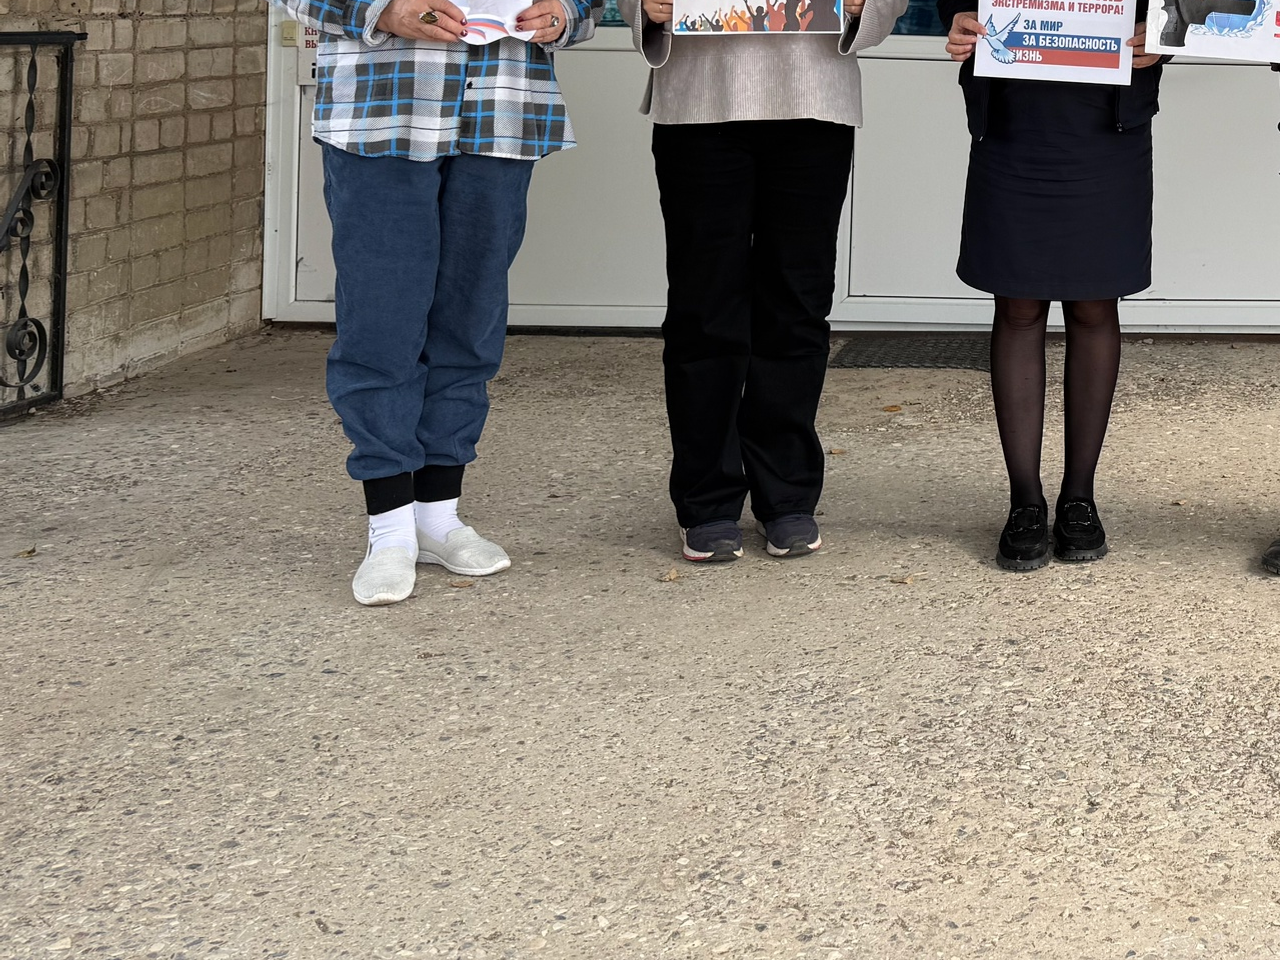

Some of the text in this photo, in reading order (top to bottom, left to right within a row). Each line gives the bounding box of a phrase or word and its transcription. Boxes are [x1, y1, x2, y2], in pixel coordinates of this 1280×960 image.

[1068, 2, 1074, 12] И
[1077, 3, 1124, 15] ТЕРРОРА!
[1023, 19, 1063, 32] ЗА МИР
[1022, 35, 1118, 51] ЗА БЕЗОПАСНОСТЬ
[1011, 49, 1042, 61] ИЗНЬ
